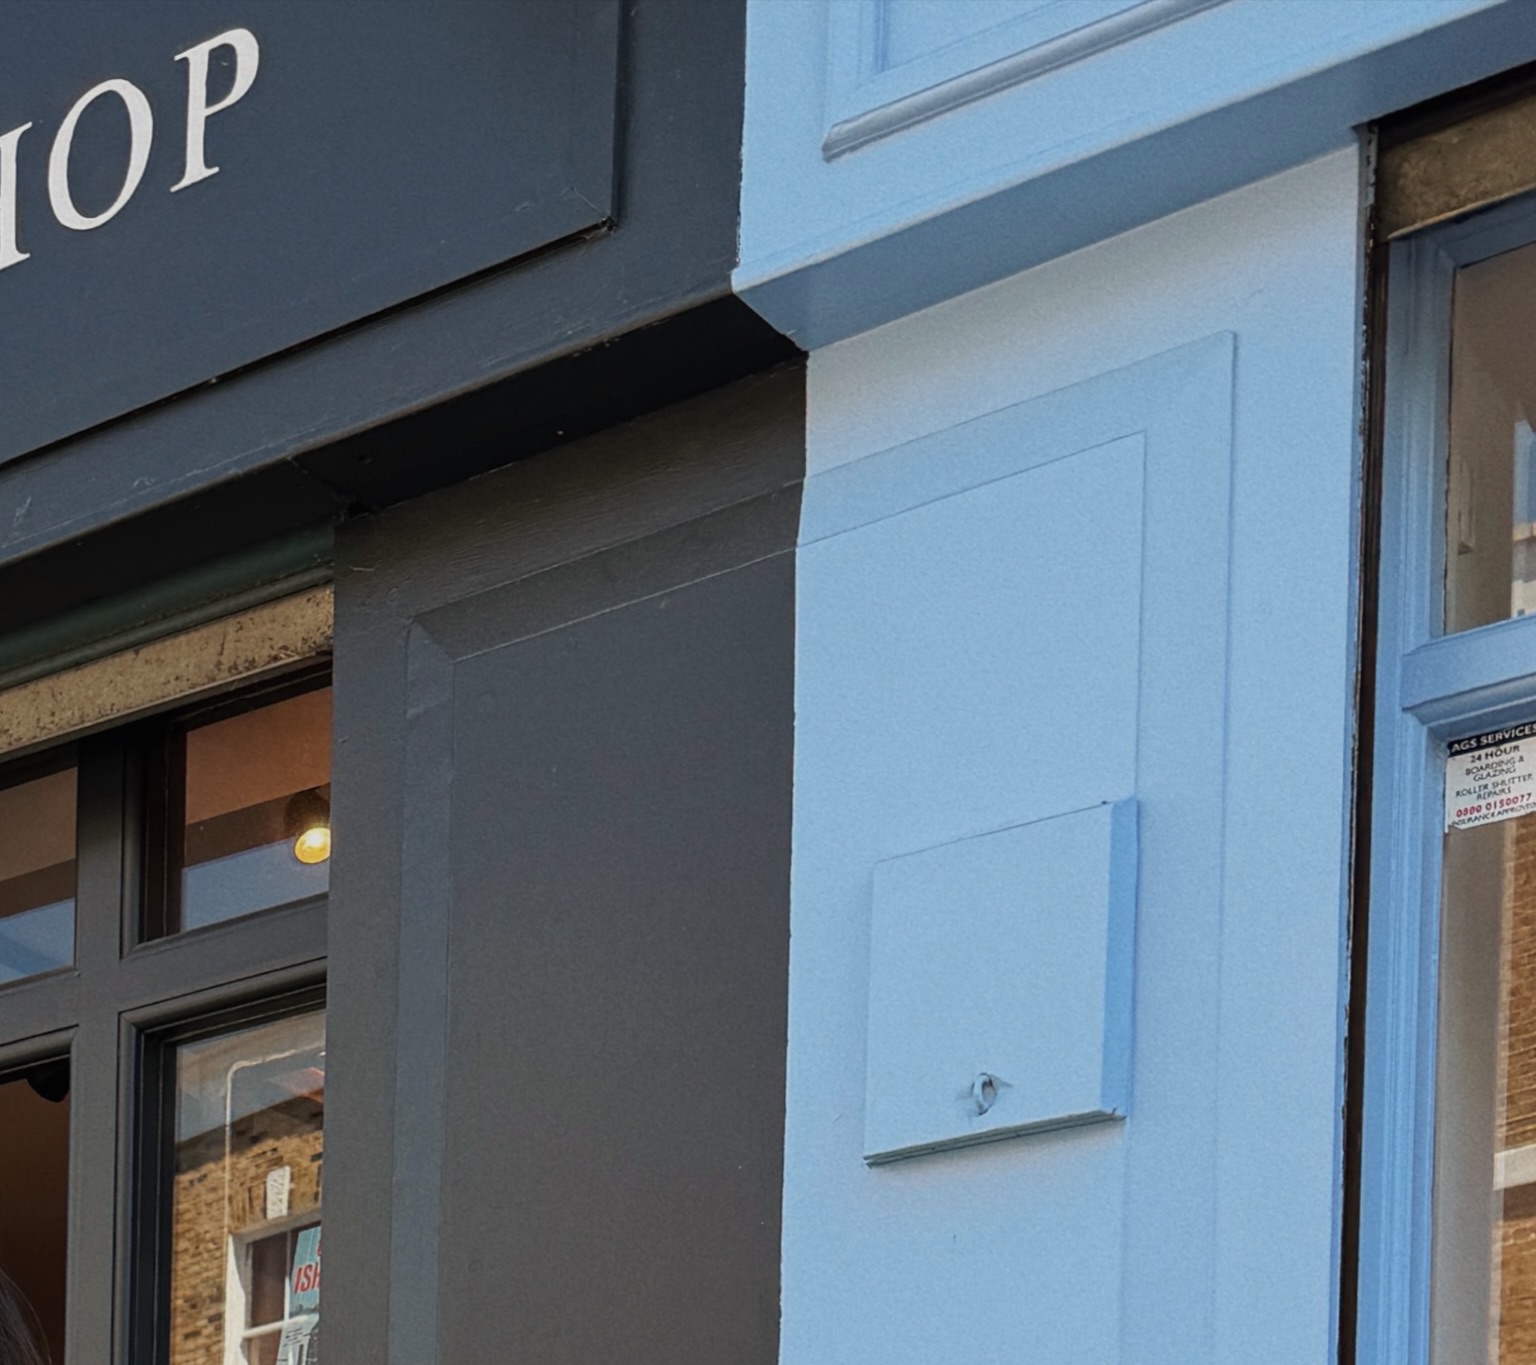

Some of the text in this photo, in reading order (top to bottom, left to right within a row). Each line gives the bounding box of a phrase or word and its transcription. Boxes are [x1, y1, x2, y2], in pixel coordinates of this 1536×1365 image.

[1451, 739, 1478, 753] AGS
[1484, 745, 1521, 761] HOUR
[1465, 756, 1517, 777] BOARDING
[1473, 766, 1517, 782] GLAZING
[1455, 773, 1533, 799] ROLLER SHUTTER
[1476, 786, 1512, 801] REPAIRS
